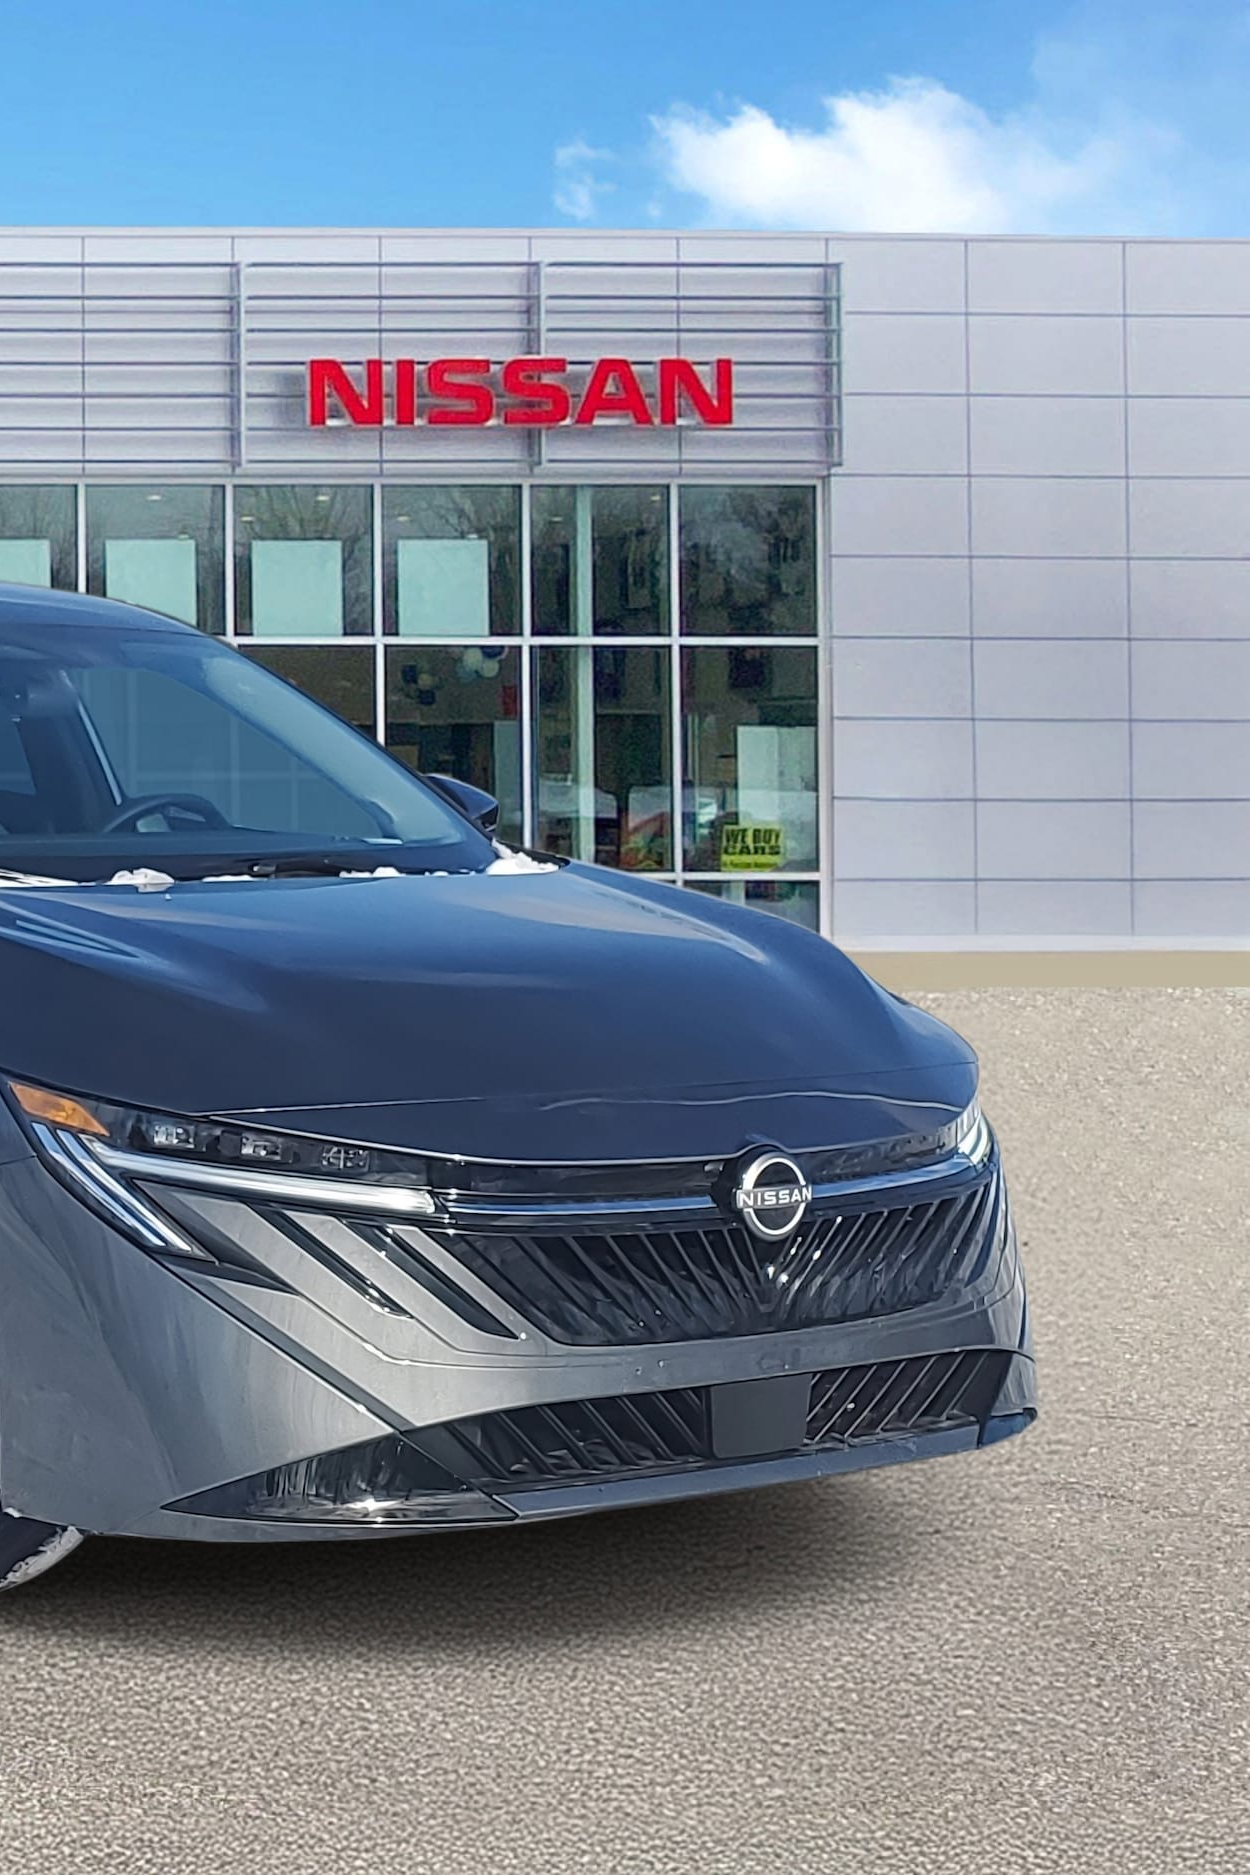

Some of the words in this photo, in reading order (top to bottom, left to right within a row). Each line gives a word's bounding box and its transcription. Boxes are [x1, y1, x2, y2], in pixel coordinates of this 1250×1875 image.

[308, 357, 734, 427] NISSAN
[725, 828, 748, 844] WE
[752, 828, 781, 844] BUY
[723, 845, 781, 855] CARS
[739, 1187, 812, 1207] NISSAN
